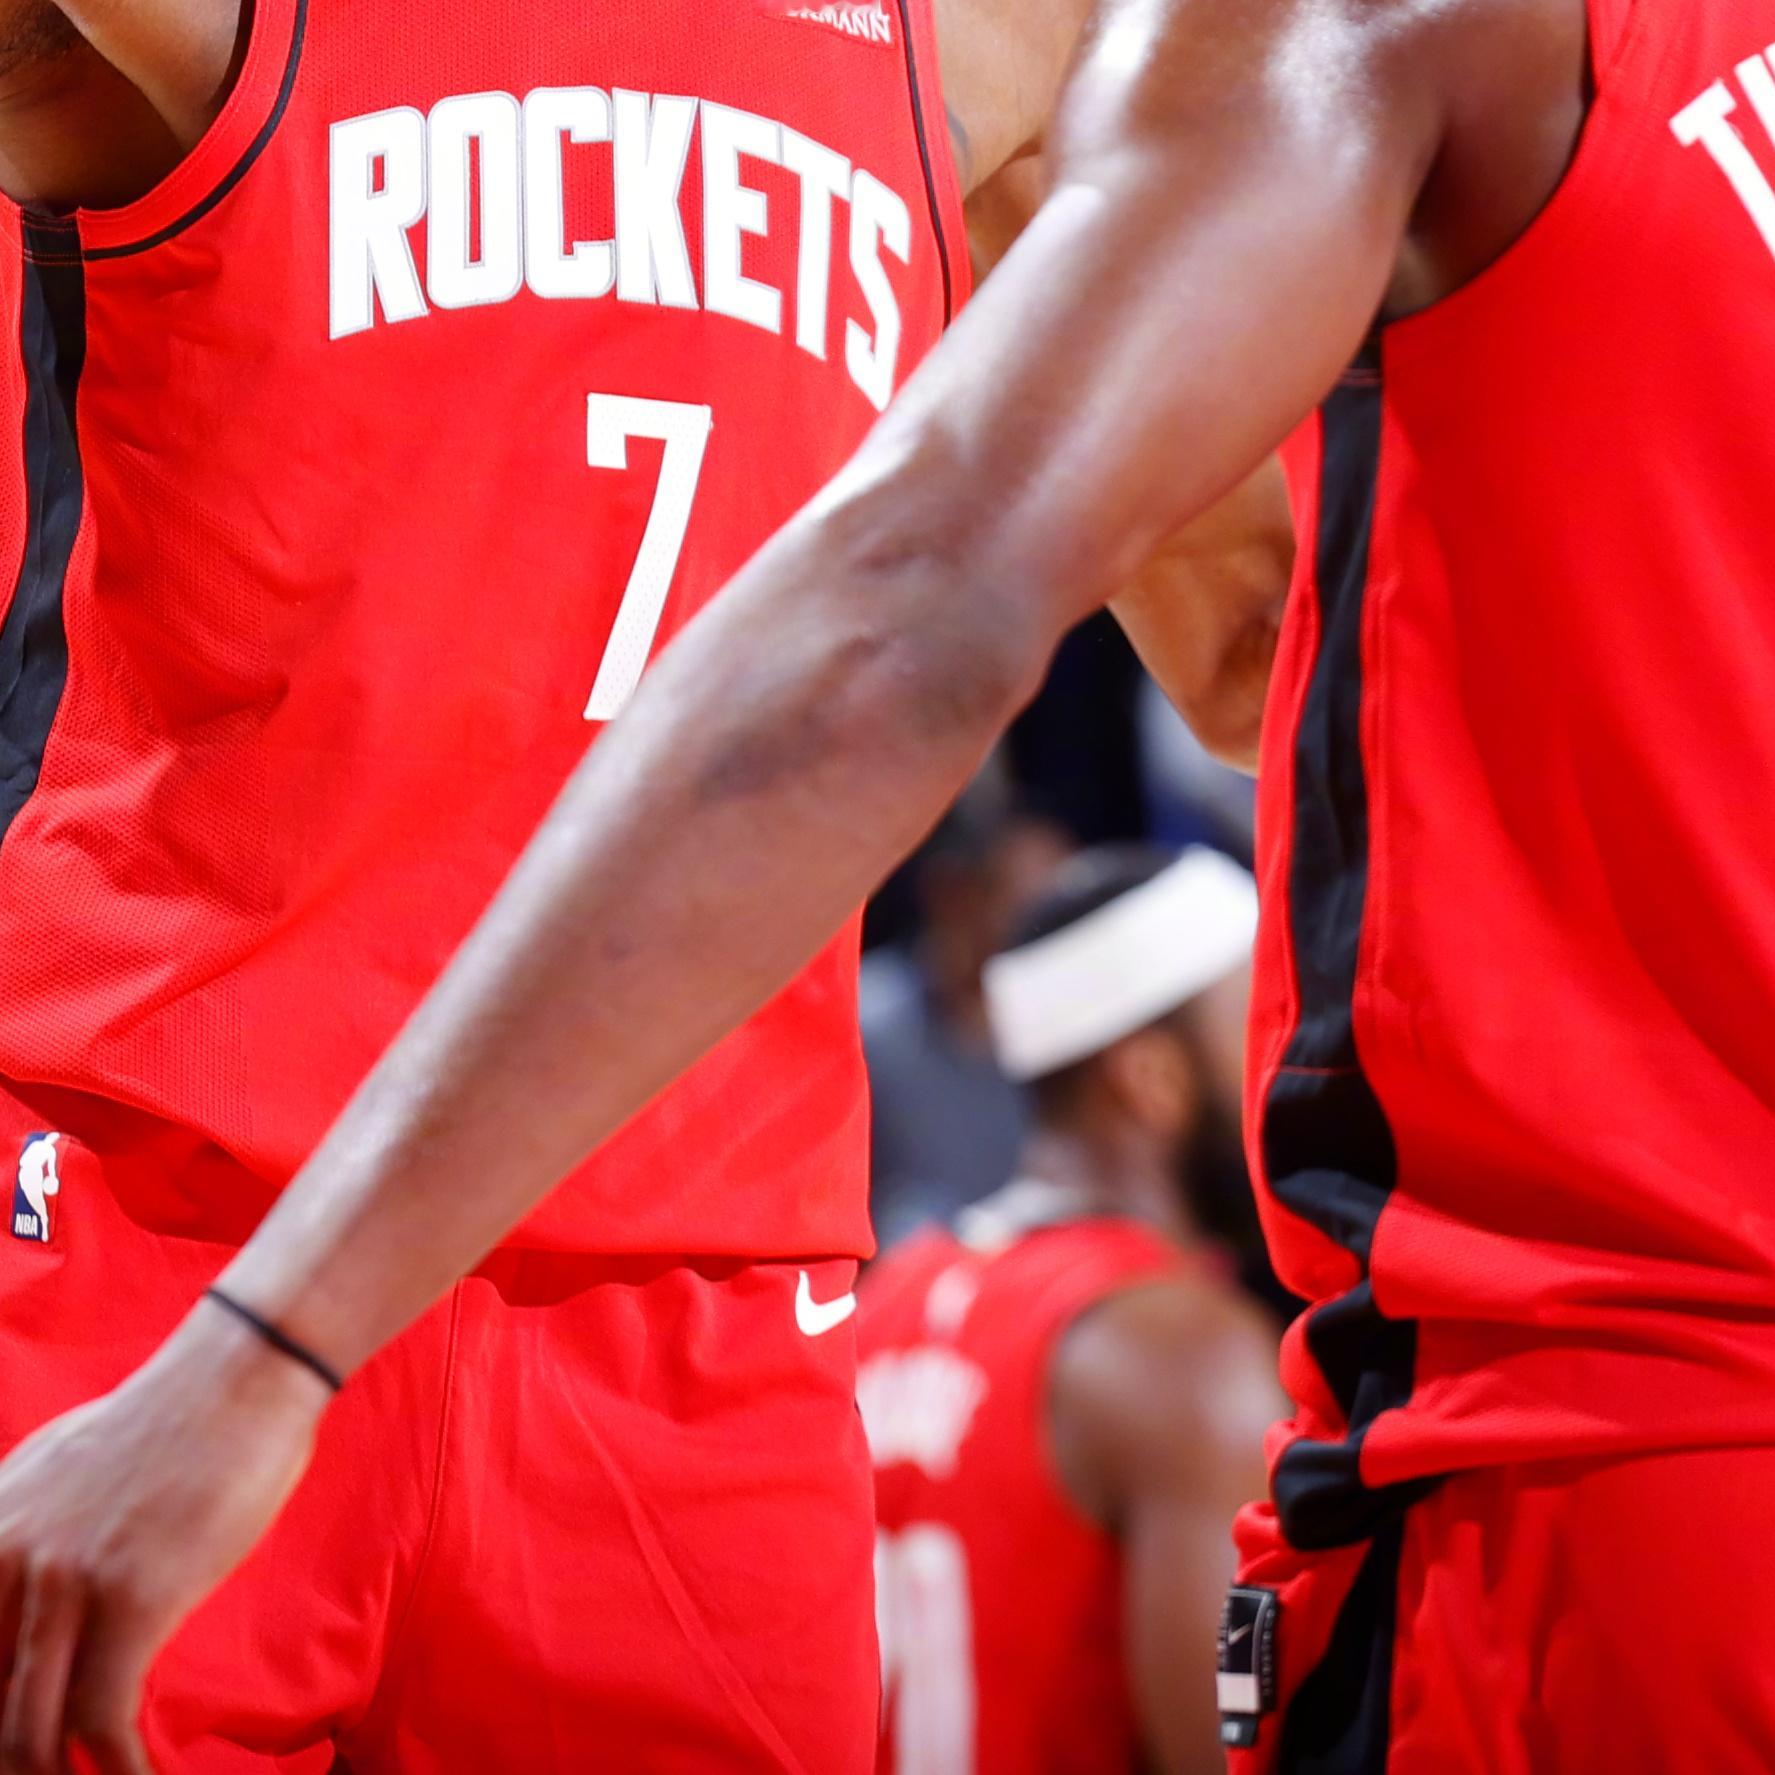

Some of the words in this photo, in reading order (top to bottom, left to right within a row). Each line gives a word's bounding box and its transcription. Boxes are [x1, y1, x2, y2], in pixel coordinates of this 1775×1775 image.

[328, 85, 912, 410] ROCKETS
[582, 391, 713, 721] 7
[14, 1212, 39, 1237] NBA
